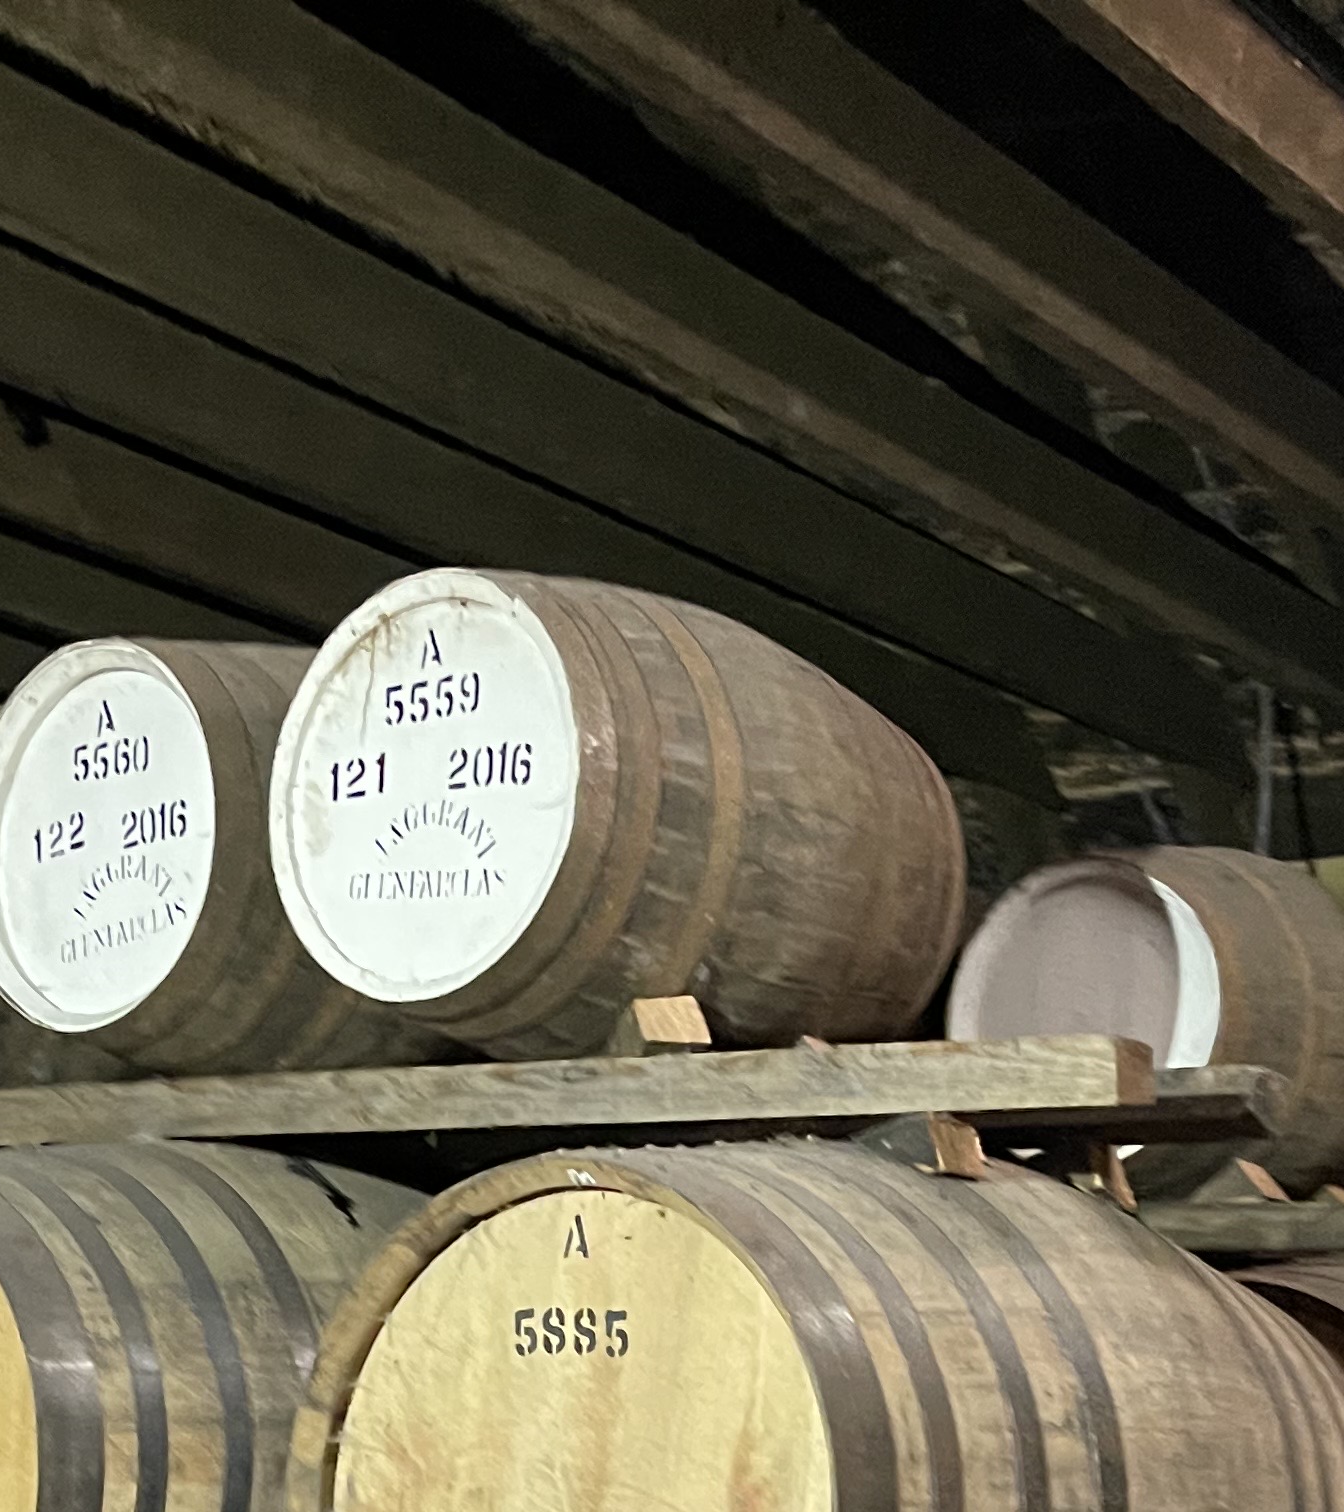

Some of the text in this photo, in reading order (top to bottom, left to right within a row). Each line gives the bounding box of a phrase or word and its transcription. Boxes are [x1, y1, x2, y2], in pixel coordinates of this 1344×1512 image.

[421, 629, 442, 670] A
[97, 700, 115, 737] A
[385, 672, 480, 725] 5559
[74, 735, 149, 782] 5560
[331, 742, 532, 802] 121 2016
[34, 799, 187, 864] 122 2016
[563, 1214, 590, 1259] A
[514, 1307, 629, 1357] 5885
